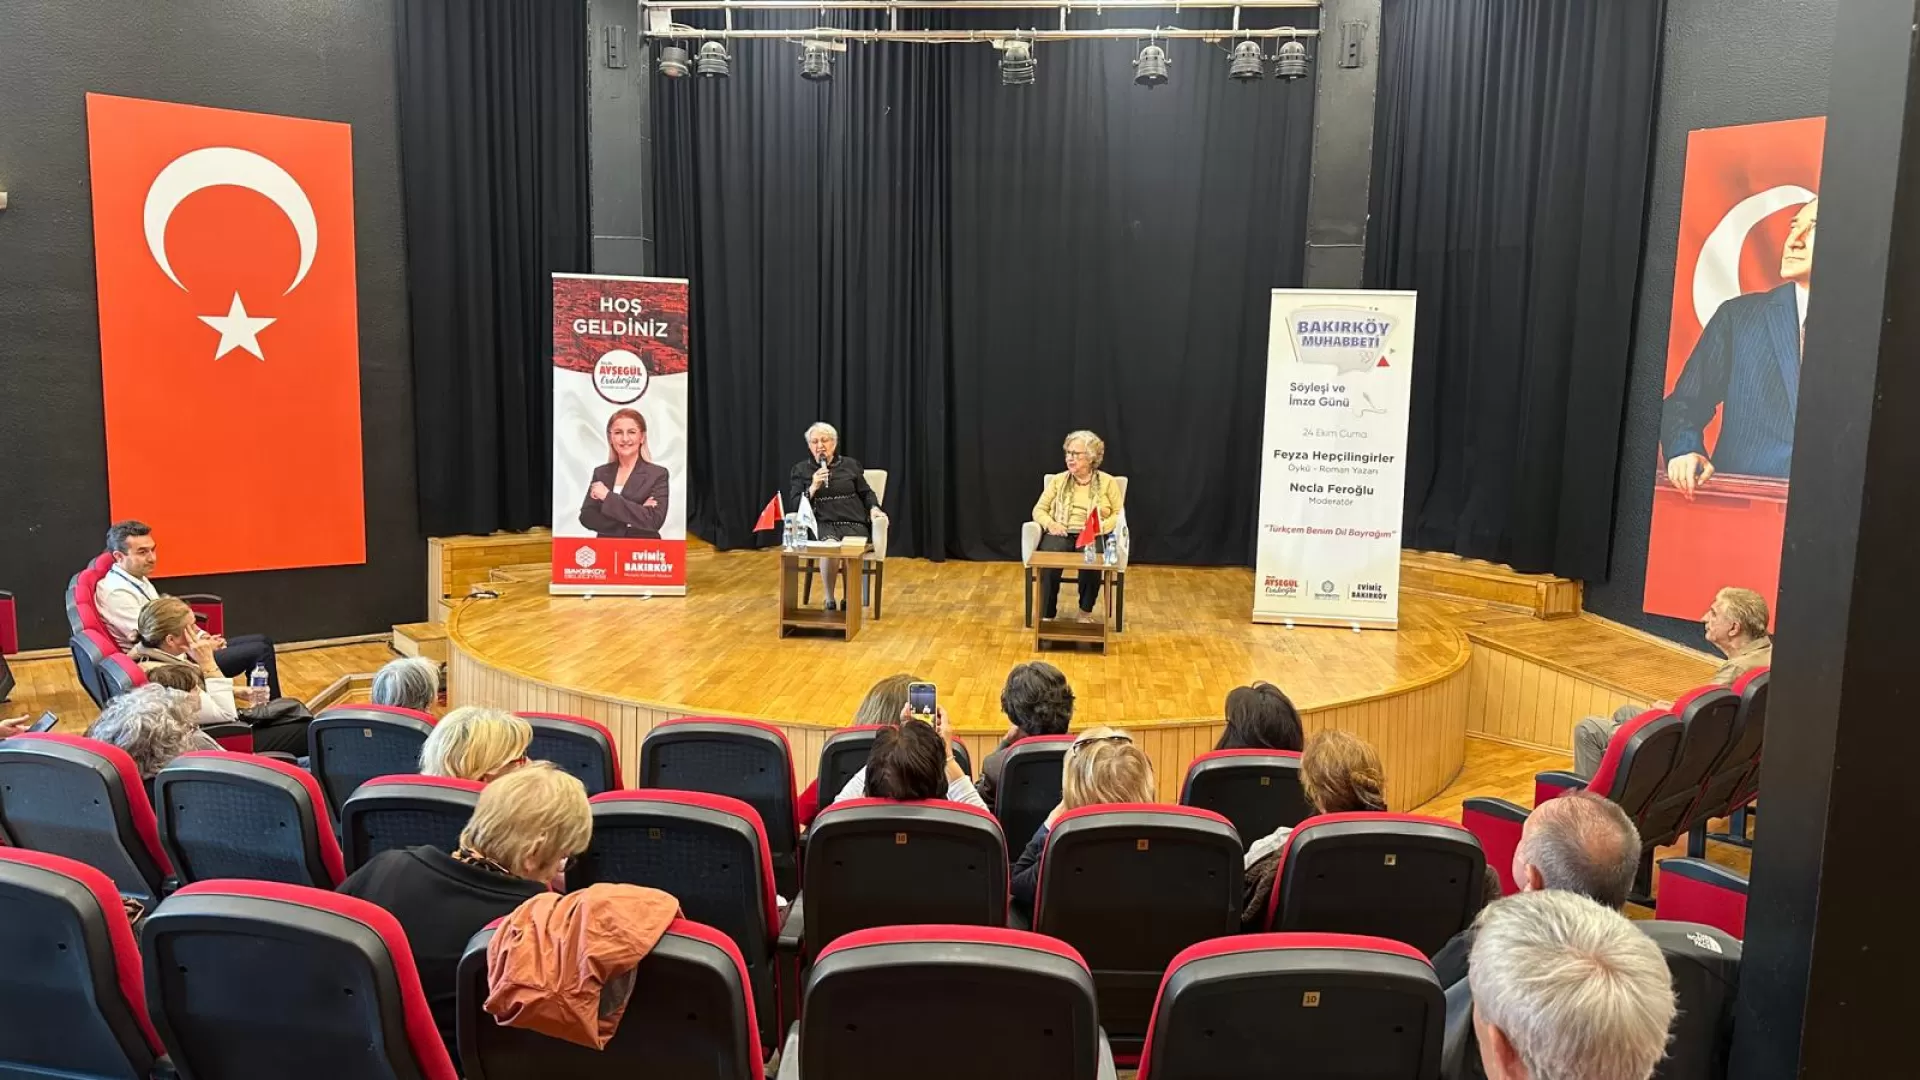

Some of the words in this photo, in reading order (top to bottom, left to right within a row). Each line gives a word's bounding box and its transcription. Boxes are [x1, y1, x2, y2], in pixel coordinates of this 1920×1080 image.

[600, 297, 642, 316] HOŞ
[573, 317, 668, 337] GELDİNİZ
[1297, 319, 1390, 336] BAKIRKÖY
[1301, 335, 1380, 348] MUHABBETİ
[1290, 382, 1329, 394] Söyleşi
[1332, 385, 1346, 393] ve
[1289, 393, 1316, 407] İmza
[1318, 397, 1350, 408] Günü
[1302, 428, 1314, 437] 24
[1316, 429, 1337, 438] Ekim
[1339, 430, 1368, 439] Cuma
[1273, 449, 1309, 461] Feyza
[1312, 451, 1395, 464] Hepçilingirler
[1319, 465, 1350, 474] Roman
[1290, 482, 1324, 493] Necla
[1327, 484, 1375, 497] Feroğlu
[1308, 497, 1354, 506] Moderatör
[1306, 527, 1334, 536] Benim
[1335, 528, 1347, 536] Dil
[632, 549, 666, 562] EVİMİZ
[624, 561, 673, 572] BAKIRKÖY
[1307, 995, 1317, 1004] 10
